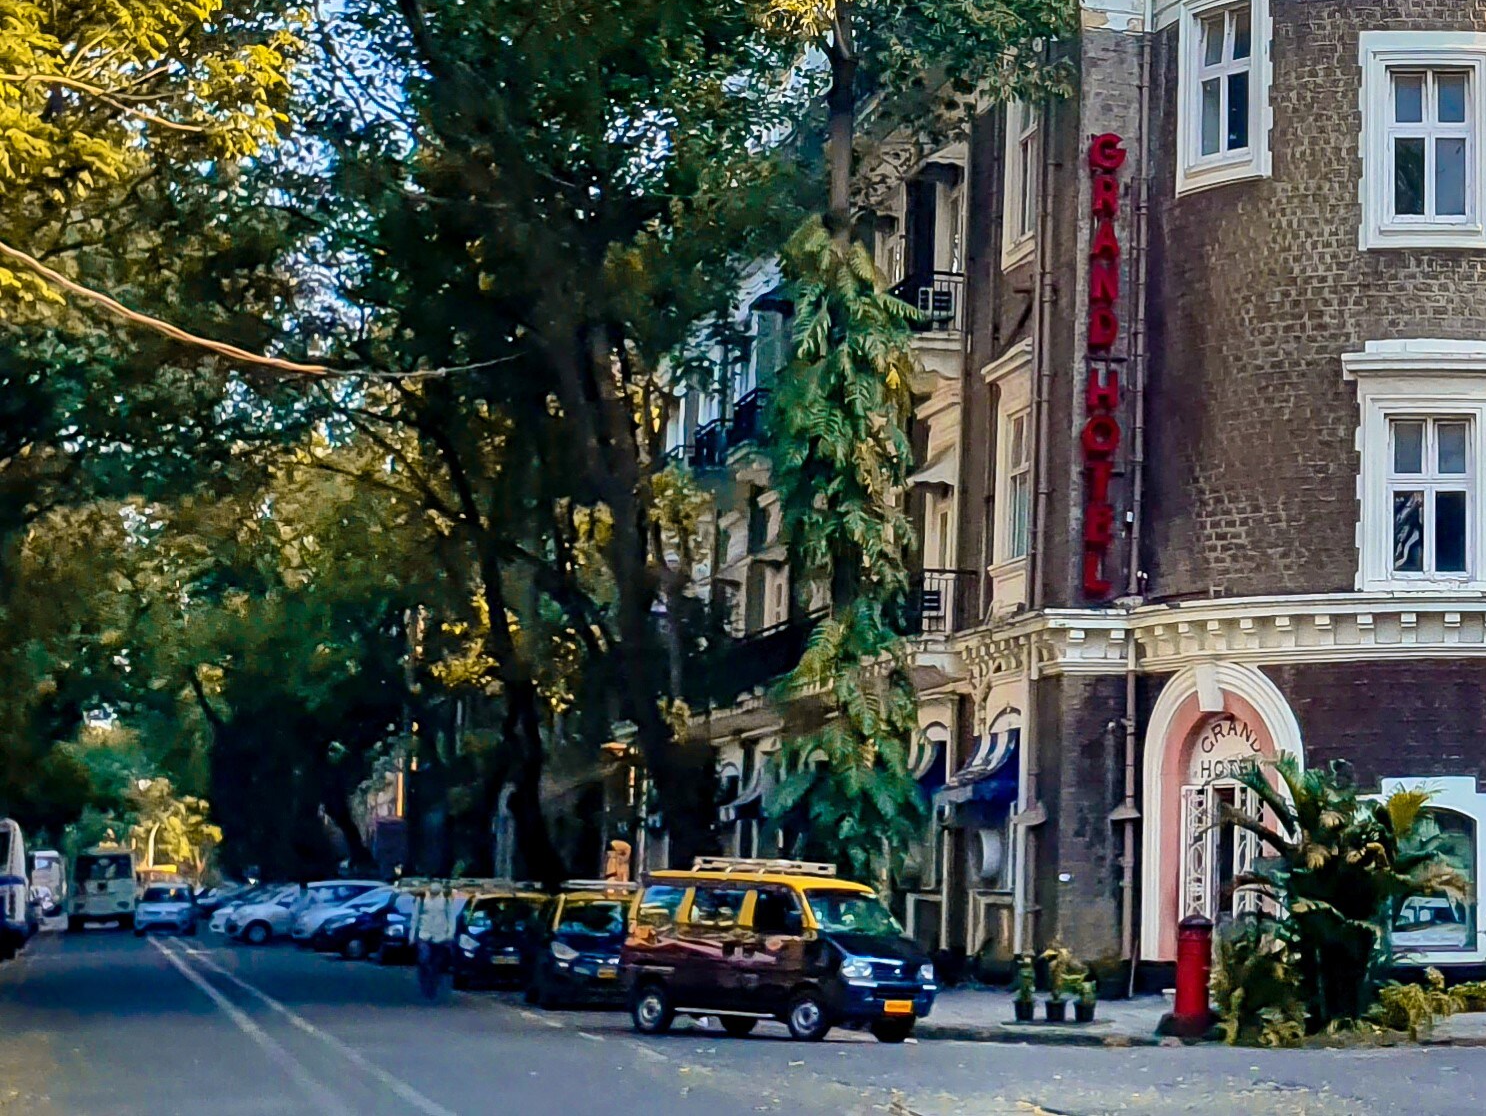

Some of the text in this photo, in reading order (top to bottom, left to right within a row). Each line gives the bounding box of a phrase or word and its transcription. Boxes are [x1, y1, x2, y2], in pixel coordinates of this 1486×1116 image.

[1082, 133, 1127, 597] GRAND HOTEL
[1201, 722, 1261, 753] GRAND
